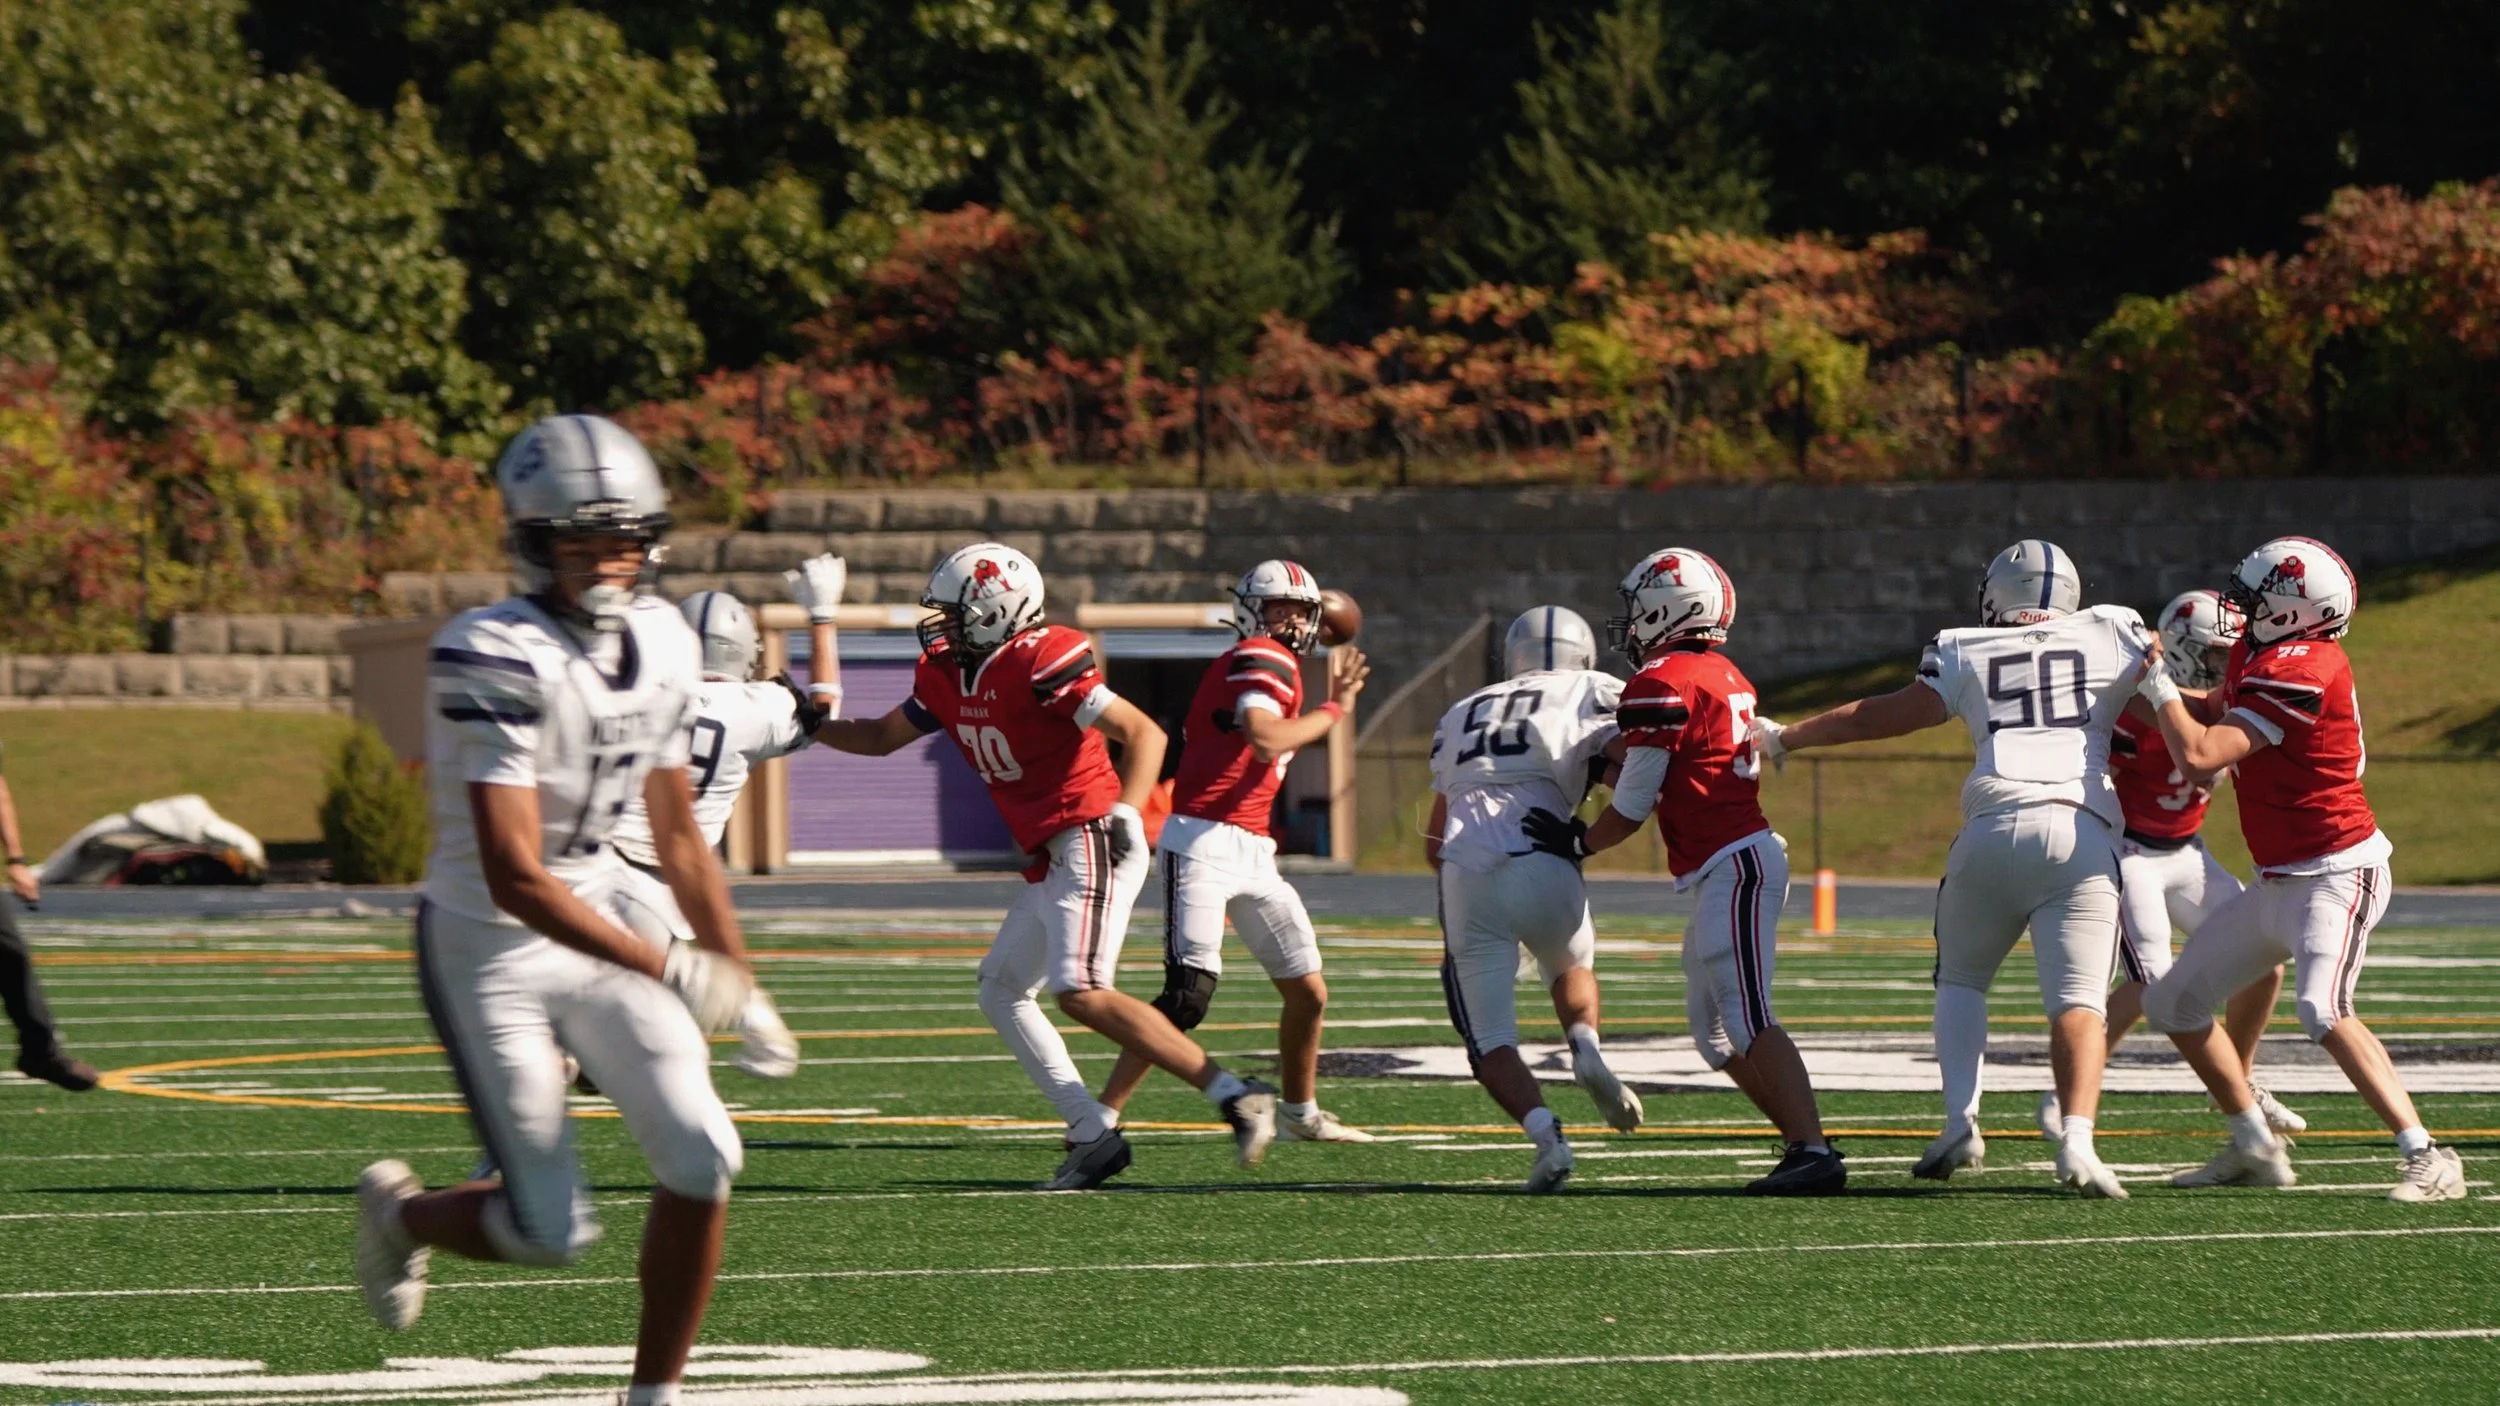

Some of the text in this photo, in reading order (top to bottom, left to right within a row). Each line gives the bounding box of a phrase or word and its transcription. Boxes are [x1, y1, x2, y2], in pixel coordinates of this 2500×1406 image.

[1456, 690, 1543, 766] 50
[1987, 650, 2091, 734] 50
[956, 723, 1023, 784] 70
